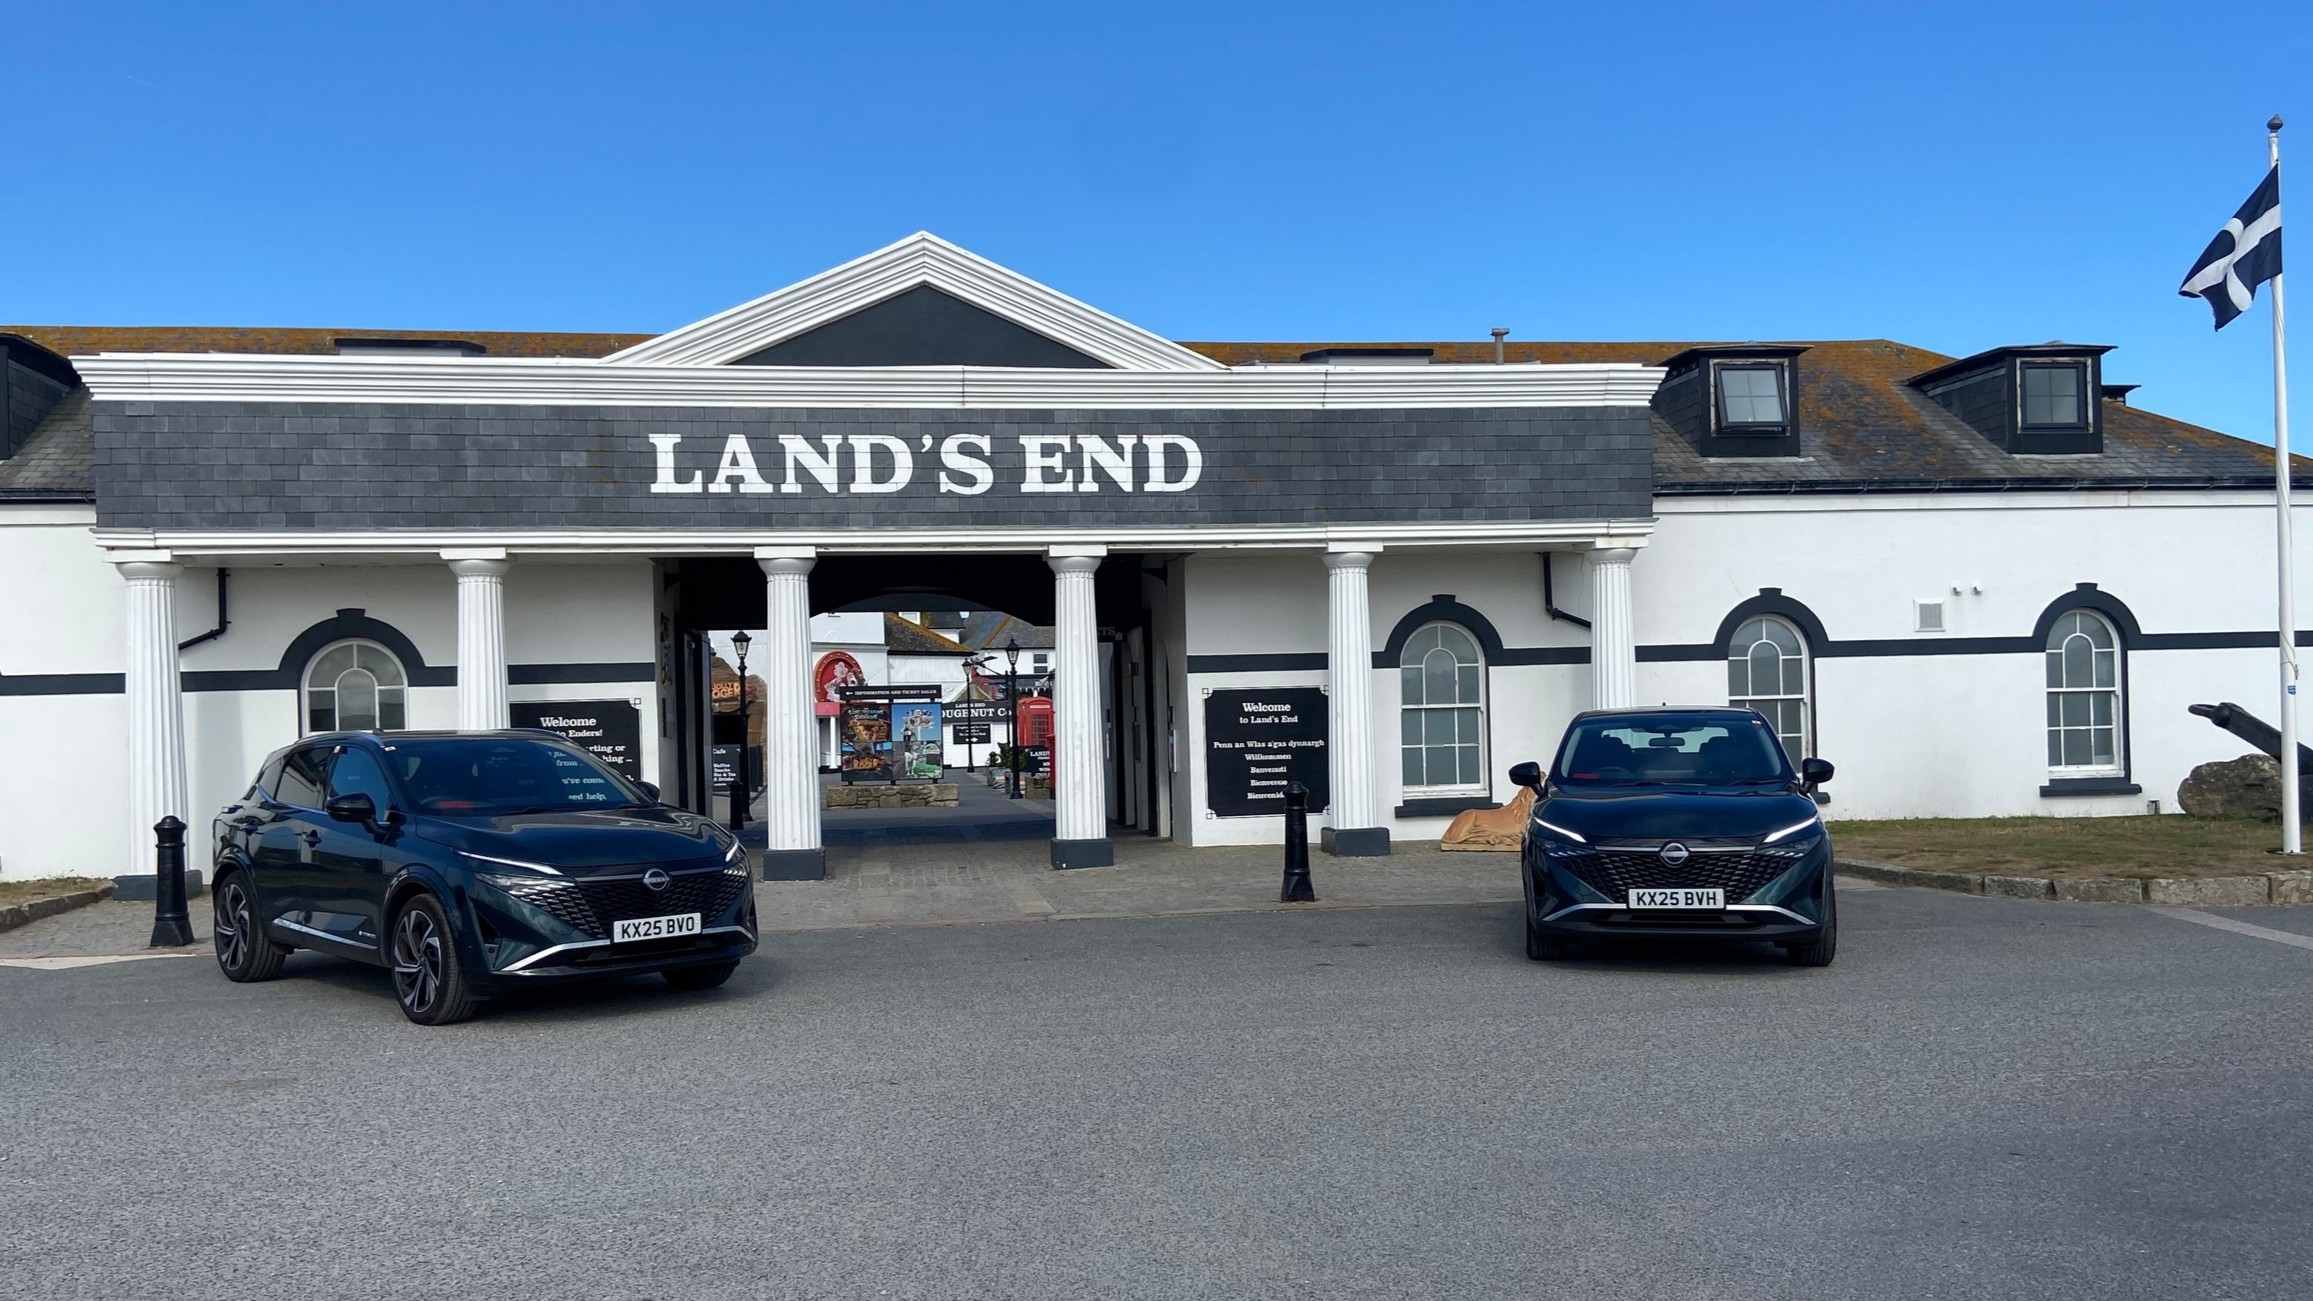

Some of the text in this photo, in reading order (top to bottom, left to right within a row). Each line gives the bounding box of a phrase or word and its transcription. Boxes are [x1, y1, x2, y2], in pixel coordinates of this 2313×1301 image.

[648, 433, 1203, 495] LAND'S END
[712, 683, 741, 699] OGER
[1242, 702, 1291, 712] Welcome
[540, 716, 597, 727] Welcome
[1281, 715, 1299, 723] End
[568, 729, 603, 738] Enders!
[1288, 739, 1325, 748] dynnargh
[1244, 753, 1292, 761] Willkommen
[1636, 891, 1717, 906] KX25 BVH
[621, 916, 695, 939] KX25 BVO
